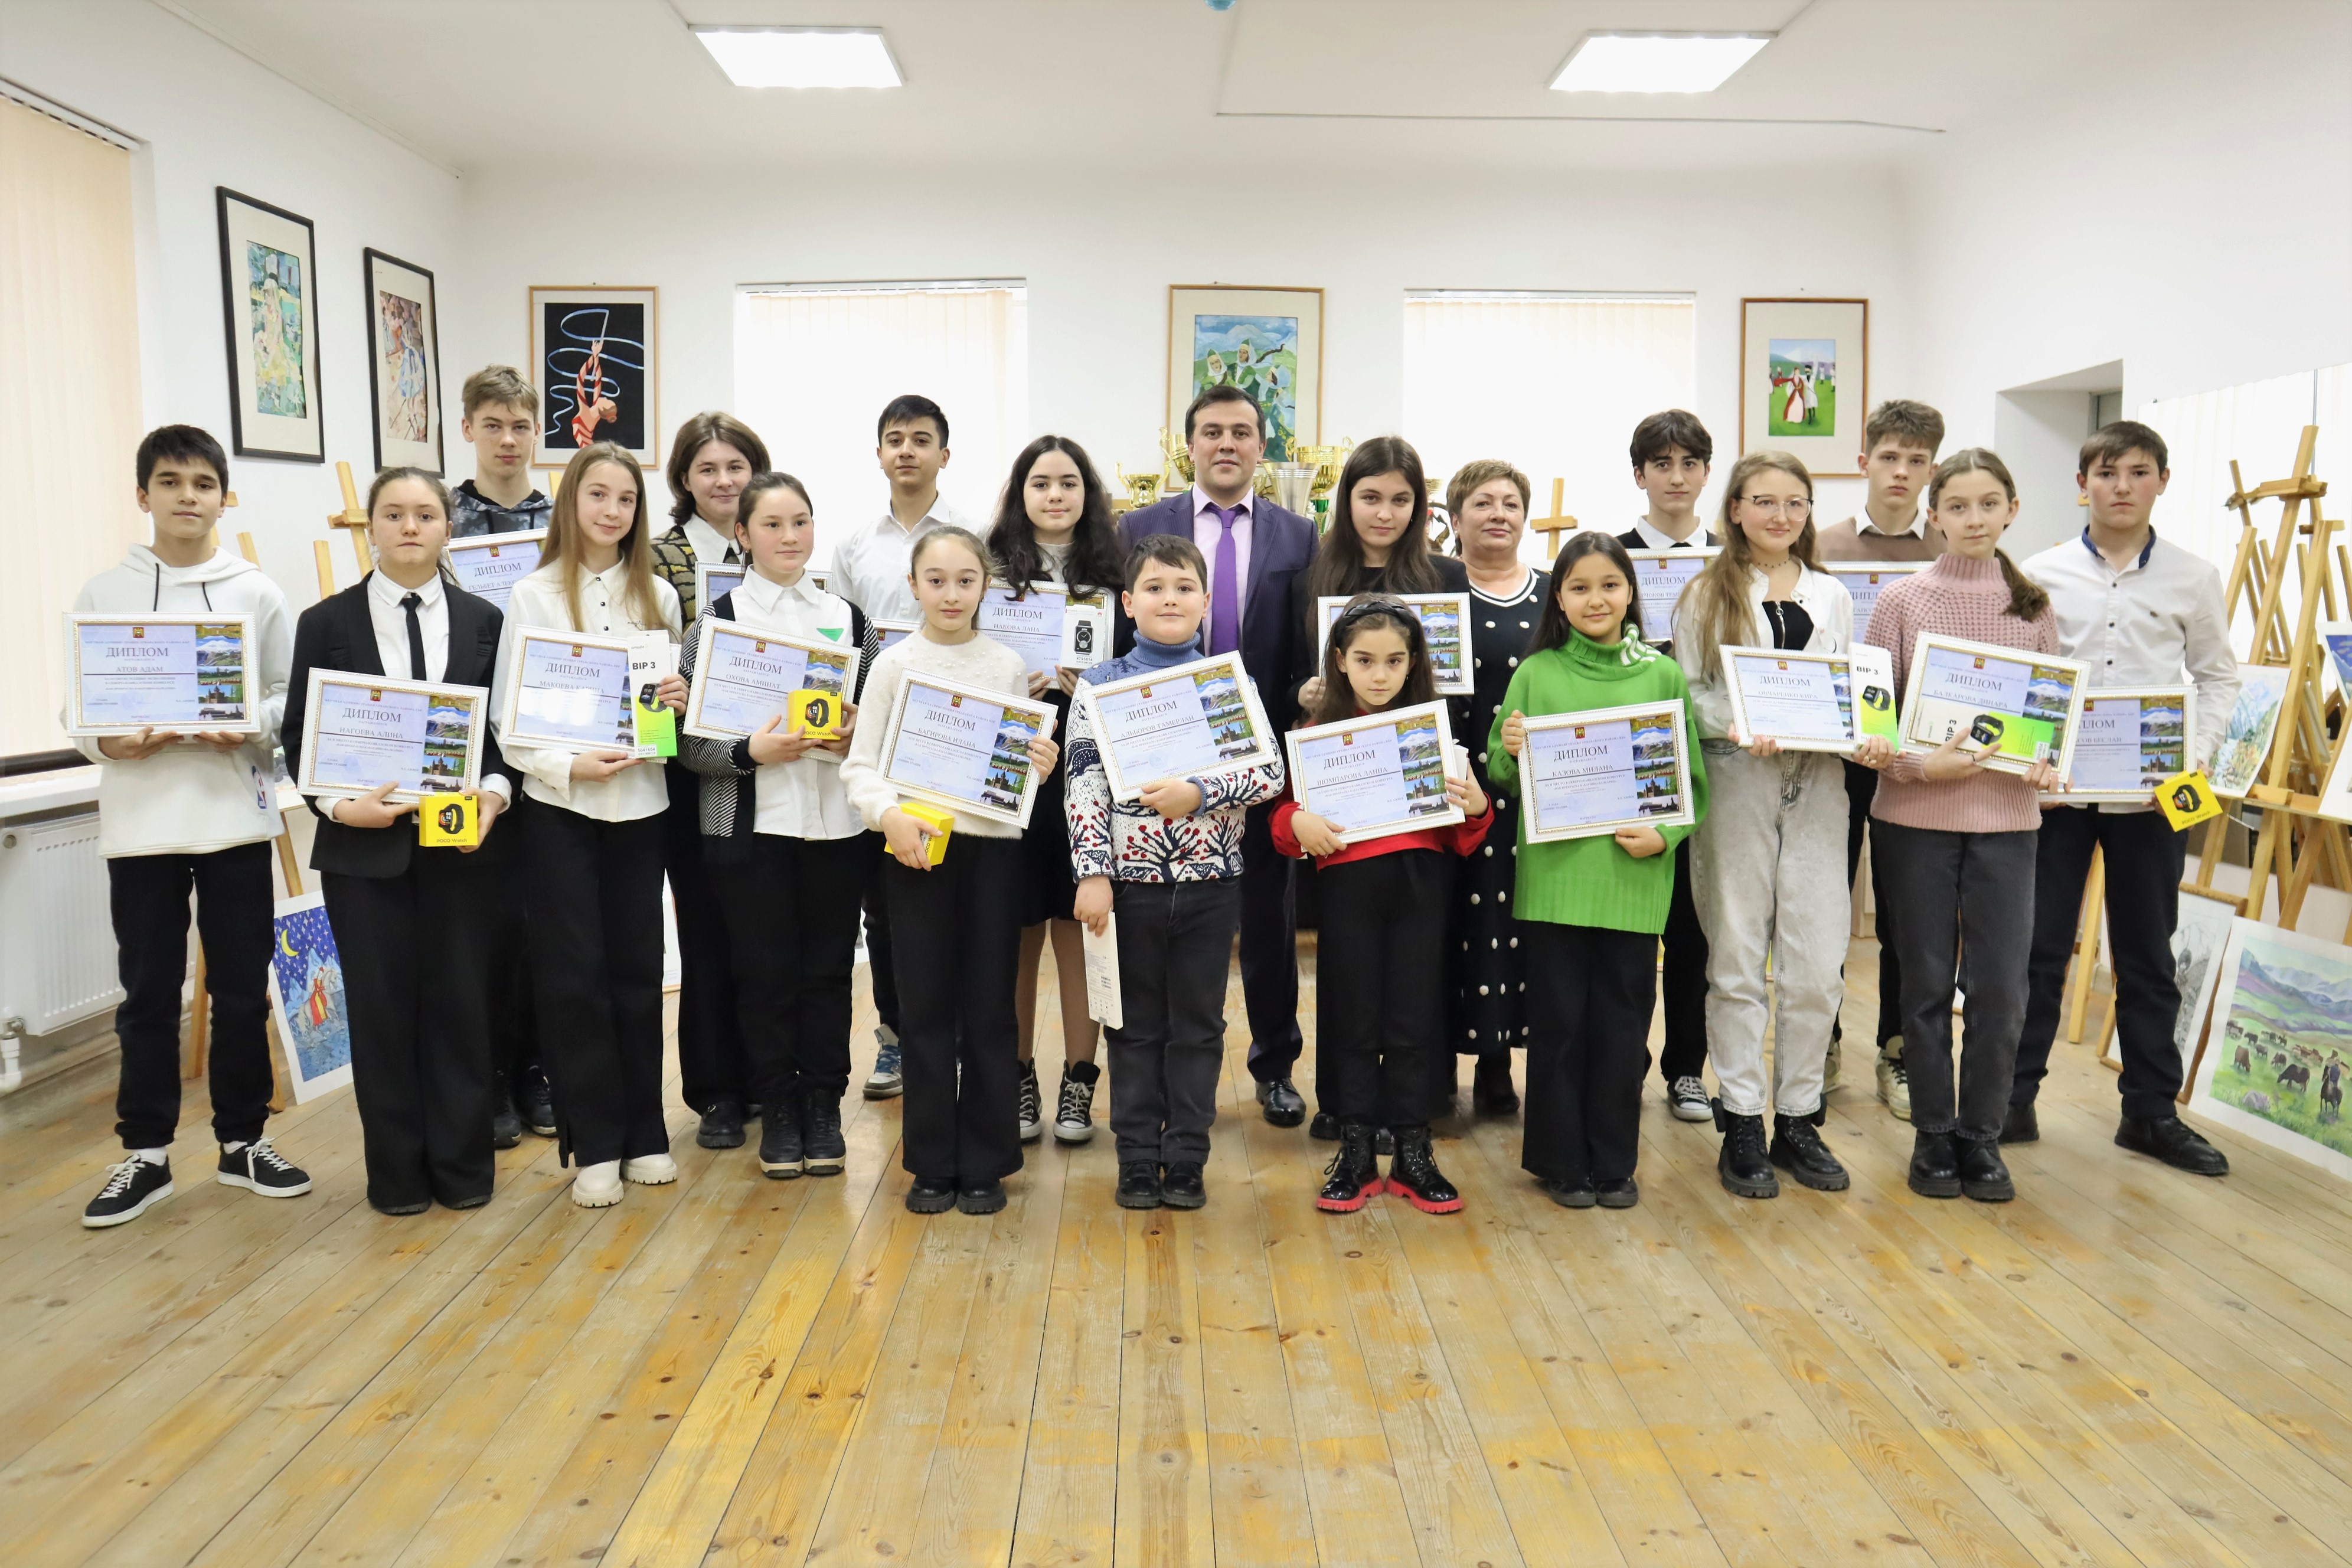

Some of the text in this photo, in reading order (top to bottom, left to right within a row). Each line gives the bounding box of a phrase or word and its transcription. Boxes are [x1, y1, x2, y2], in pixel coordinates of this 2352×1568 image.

[474, 563, 521, 577] ДИПЛОМ
[1642, 576, 1685, 586] ДИПЛОМ
[992, 607, 1042, 620] ДИПЛОМ
[105, 647, 168, 657] ДИПЛОМ
[545, 662, 600, 678] ДИПЛОМ
[632, 662, 648, 670] BIP
[729, 656, 782, 675] ДИПЛОМ
[540, 681, 574, 690] МАКОЕВА
[726, 674, 780, 689] ОХОВА АМИНАТ
[1759, 676, 1810, 687] ДИПЛОМ
[1946, 672, 2002, 692] ДИПЛОМ
[342, 707, 401, 723] ДИПЛОМ
[1124, 700, 1177, 722] ДИПЛОМ
[925, 709, 975, 732] ДИПЛОМ
[1120, 715, 1194, 738] АЛЬБОРОВ ТАМЕРЛАН
[2079, 720, 2115, 729] ПЛОМ
[918, 727, 975, 748] БАГИРОВА ИЛАНА
[1323, 750, 1376, 769] ДИПЛОМ
[1553, 745, 1608, 762] ДИПЛОМ
[1552, 765, 1613, 777] КАЗОВА МИЛАНА
